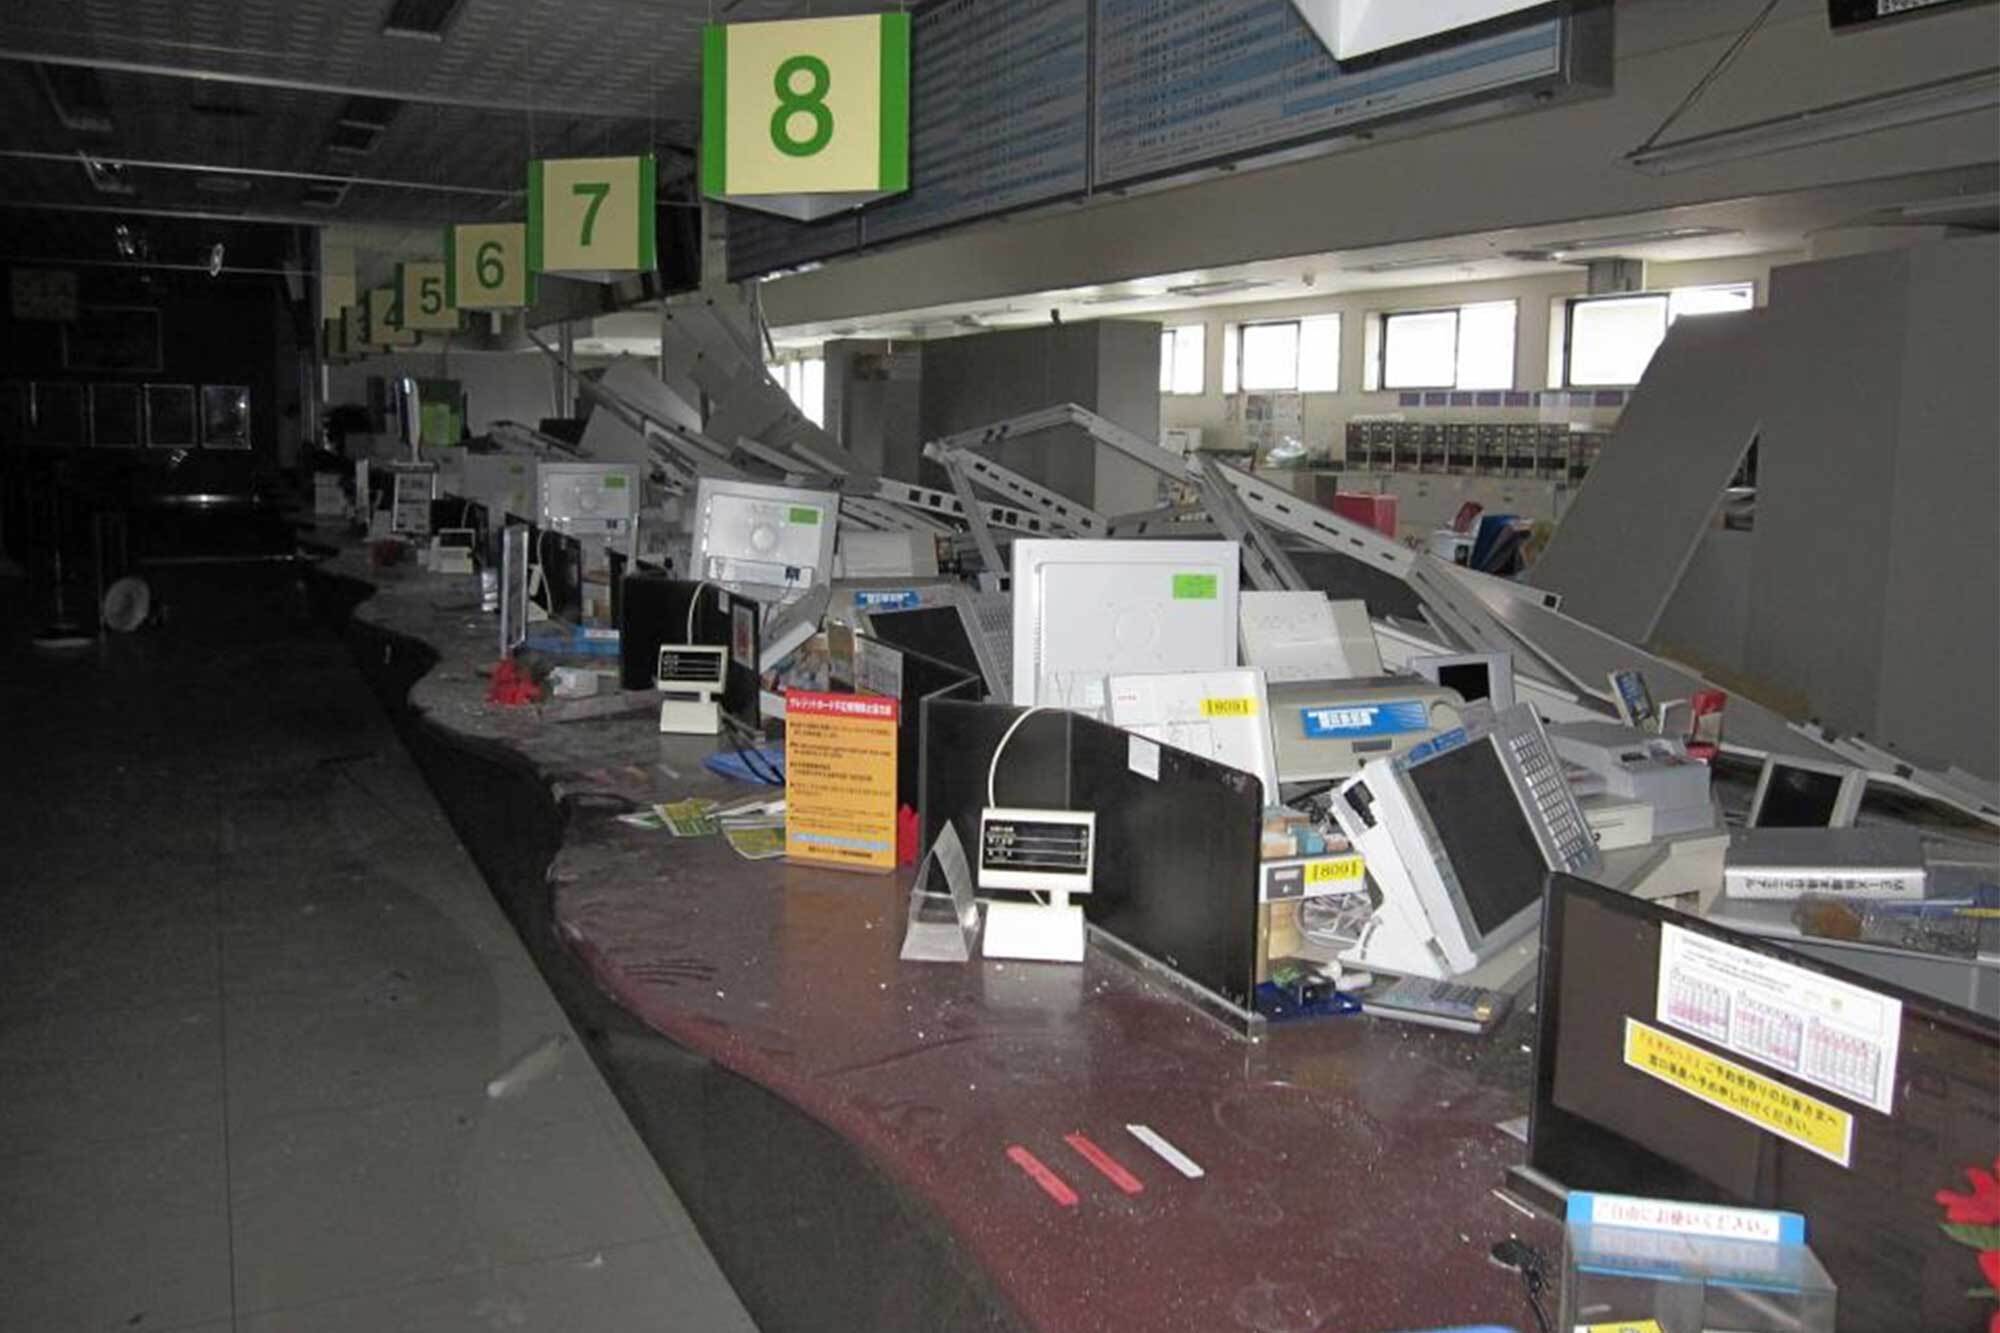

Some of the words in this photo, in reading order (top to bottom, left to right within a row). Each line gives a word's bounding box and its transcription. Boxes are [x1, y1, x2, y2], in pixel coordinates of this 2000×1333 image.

[770, 55, 834, 157] 8
[573, 183, 610, 246] 7
[476, 241, 504, 289] 6
[420, 277, 442, 315] 5
